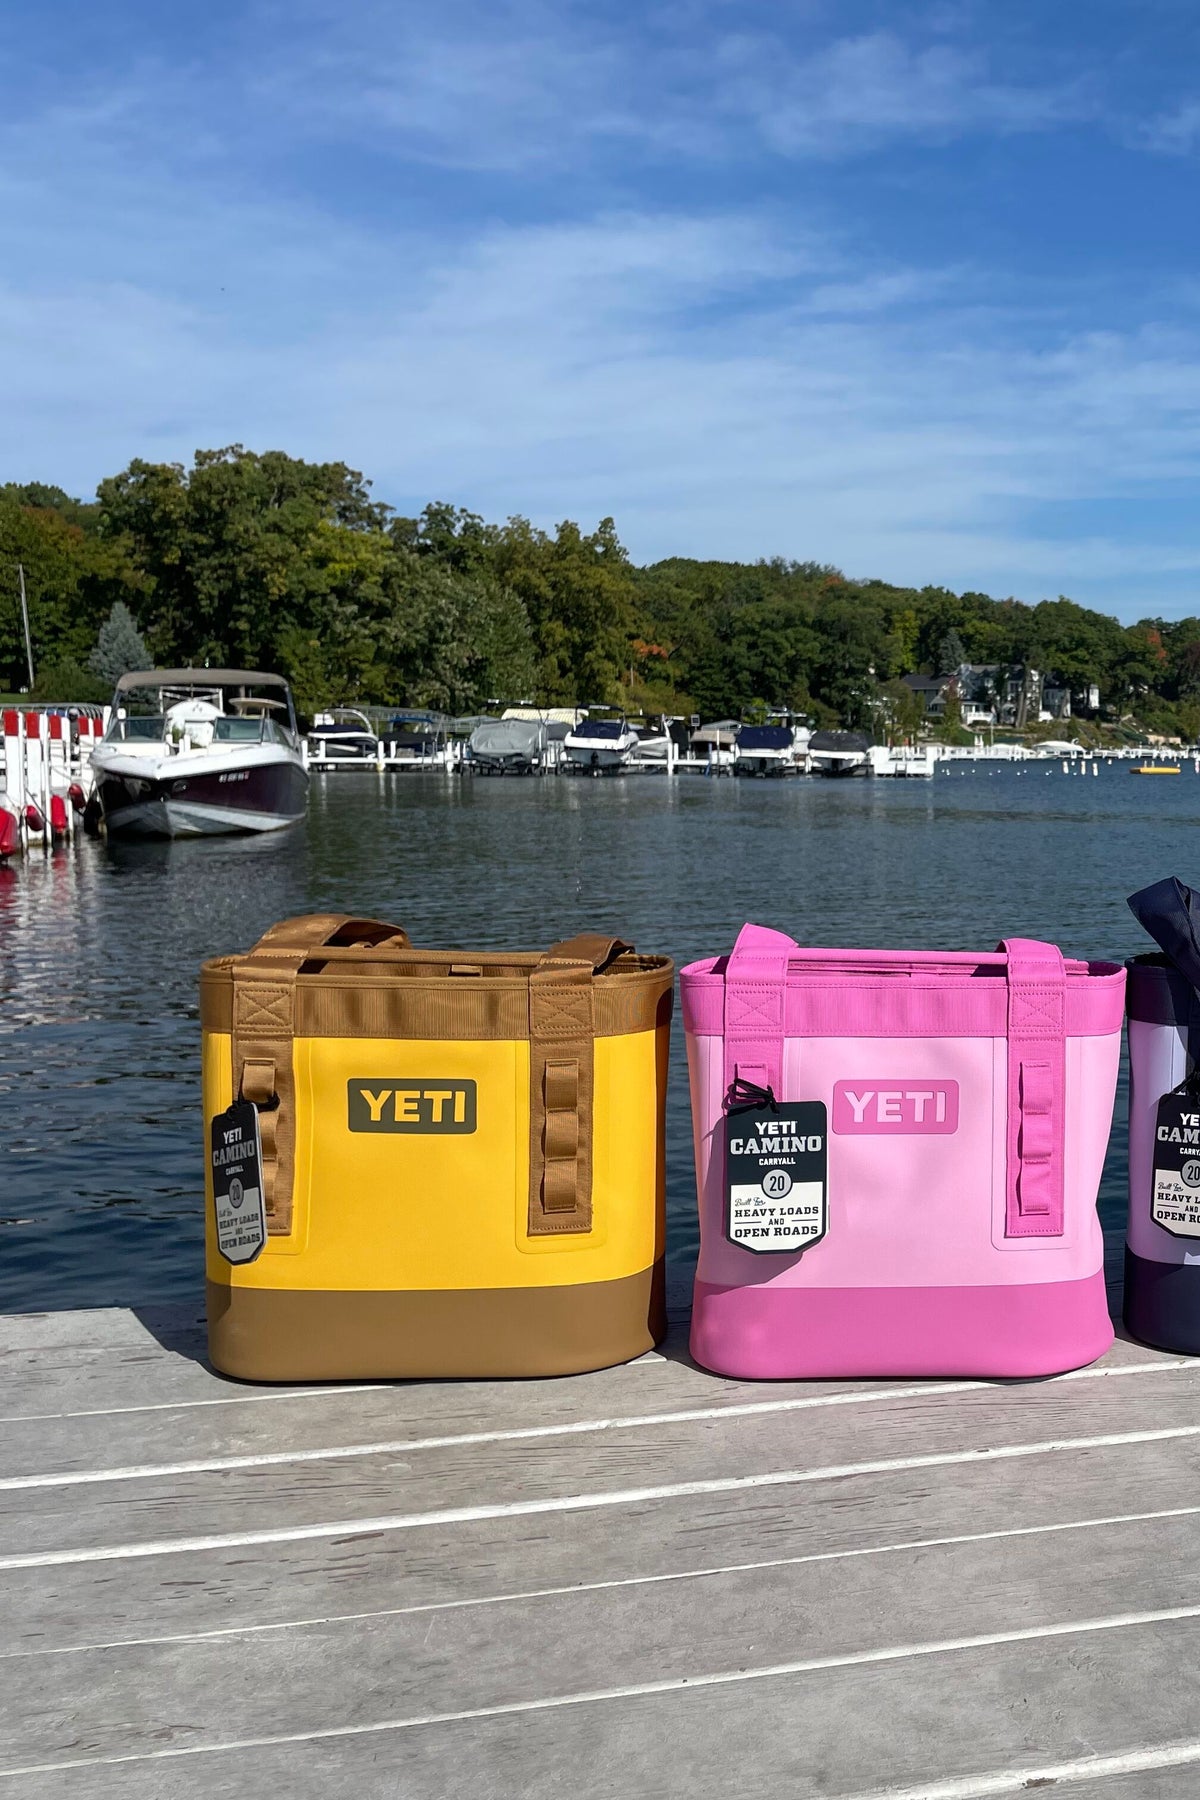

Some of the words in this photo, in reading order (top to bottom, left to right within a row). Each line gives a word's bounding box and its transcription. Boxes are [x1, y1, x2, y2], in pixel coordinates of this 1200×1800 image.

[360, 1090, 466, 1123] YETI
[844, 1091, 946, 1123] YETI
[755, 1121, 796, 1135] YETI
[223, 1127, 242, 1144] YETI
[730, 1135, 822, 1155] CAMINO
[213, 1140, 255, 1167] CAMINO
[758, 1157, 796, 1166] CARRYALL
[1187, 1165, 1200, 1180] 20
[769, 1175, 785, 1192] 20
[1157, 1192, 1192, 1203] HEAVY
[735, 1208, 776, 1217] HEAVY
[779, 1206, 819, 1216] LOADS
[1157, 1210, 1187, 1222] OPEN
[1185, 1205, 1199, 1213] AND
[768, 1218, 785, 1226] AND
[735, 1227, 770, 1238] OPEN
[774, 1226, 818, 1236] ROADS
